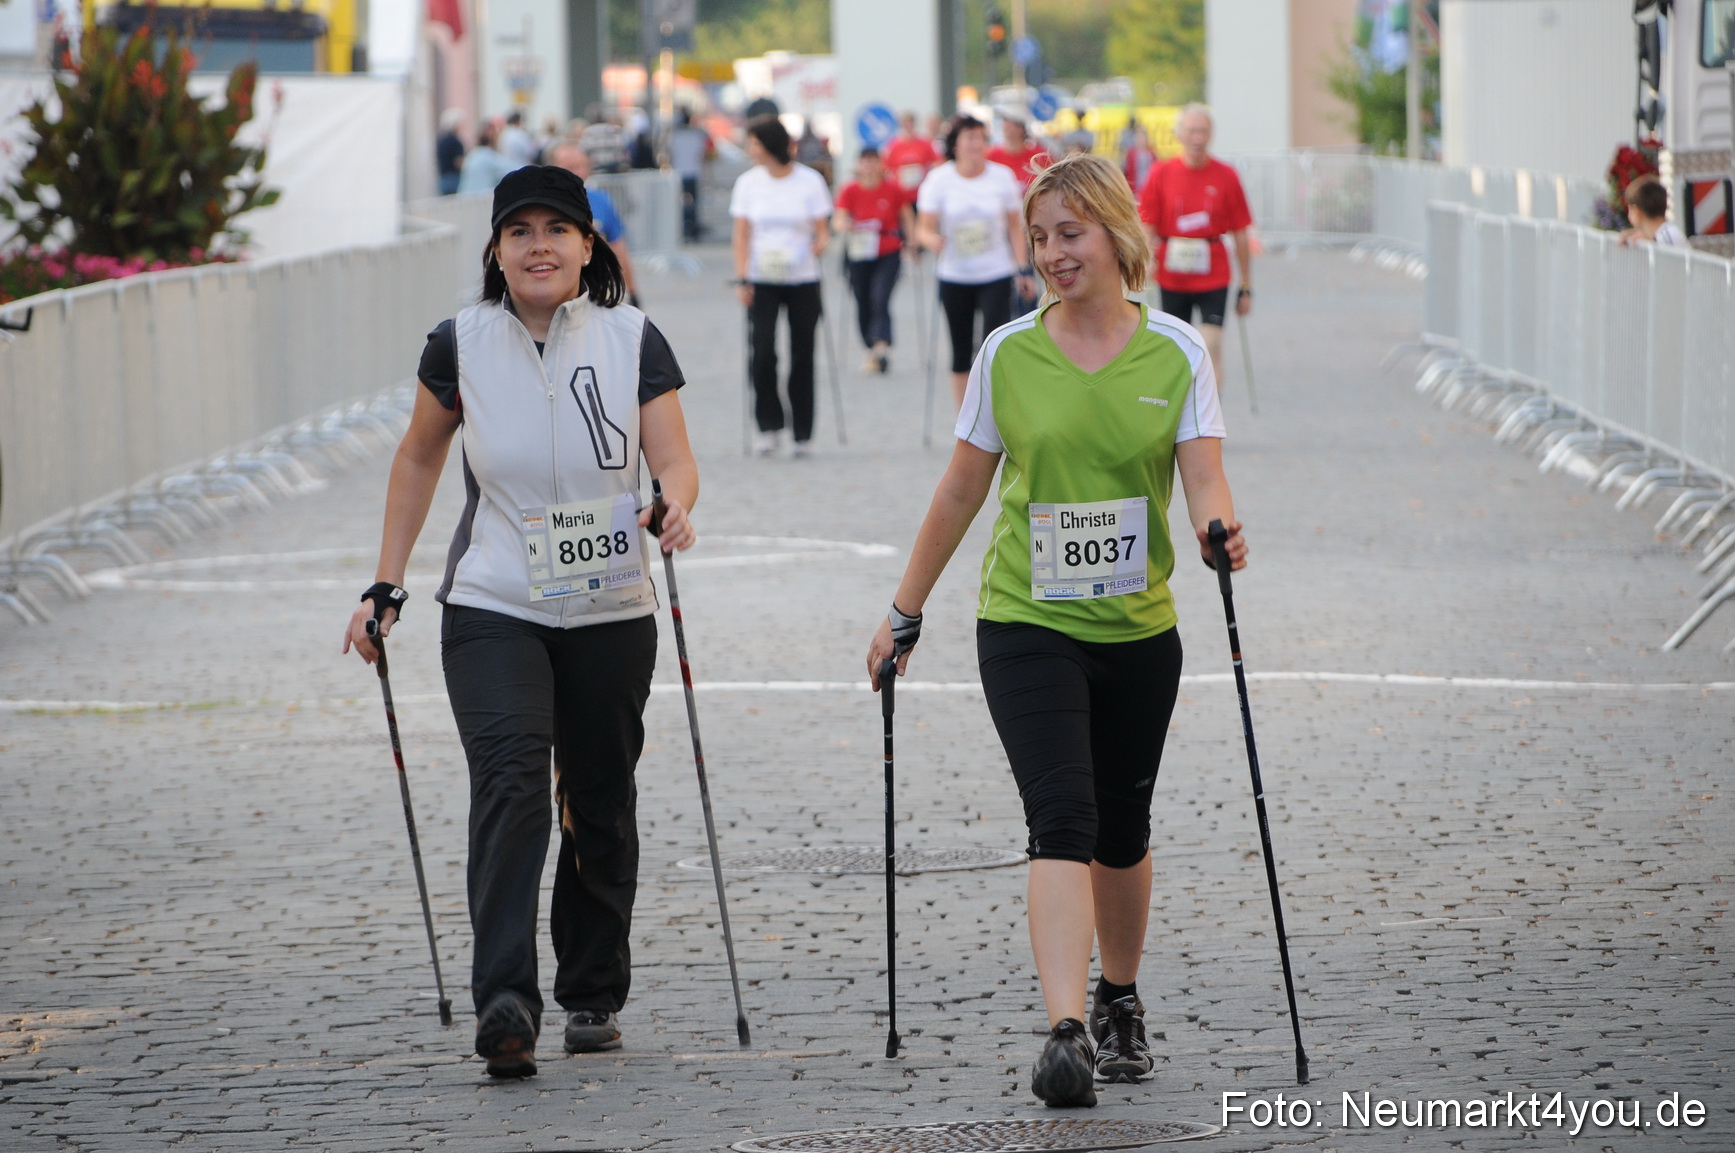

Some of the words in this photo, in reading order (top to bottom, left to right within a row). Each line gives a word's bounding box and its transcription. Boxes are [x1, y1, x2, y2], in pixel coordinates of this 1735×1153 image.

[552, 511, 595, 529] Maria
[1060, 511, 1116, 529] Christa
[529, 543, 537, 556] N
[558, 530, 630, 565] 8038
[1035, 540, 1043, 553] N
[1064, 534, 1137, 567] 8037
[600, 569, 641, 584] PFLEIDERER
[1105, 576, 1146, 590] PFLEIDERER
